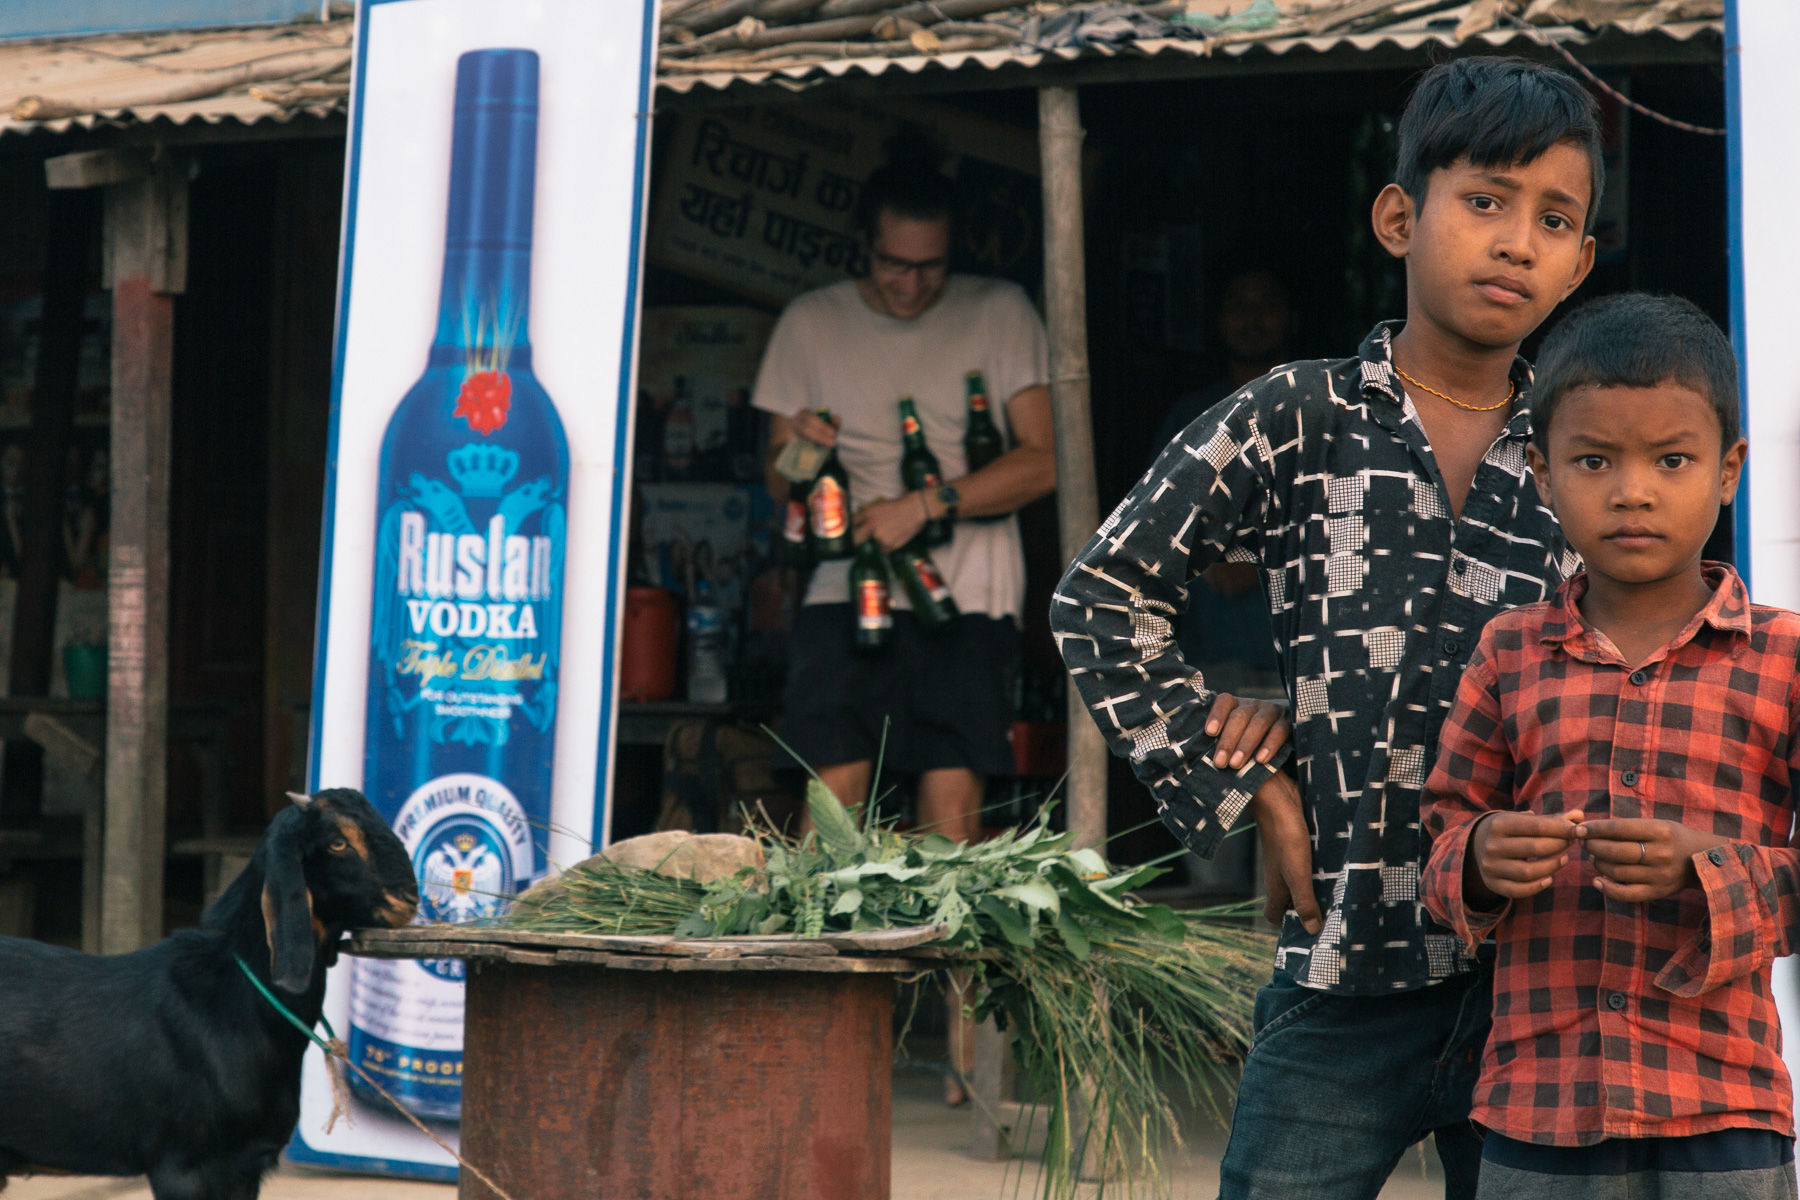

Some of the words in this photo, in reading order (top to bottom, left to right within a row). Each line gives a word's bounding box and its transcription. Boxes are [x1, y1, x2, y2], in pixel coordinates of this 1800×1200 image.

[398, 511, 551, 600] Ruslan
[406, 600, 538, 638] VODKA
[399, 786, 470, 840] PREMIUM
